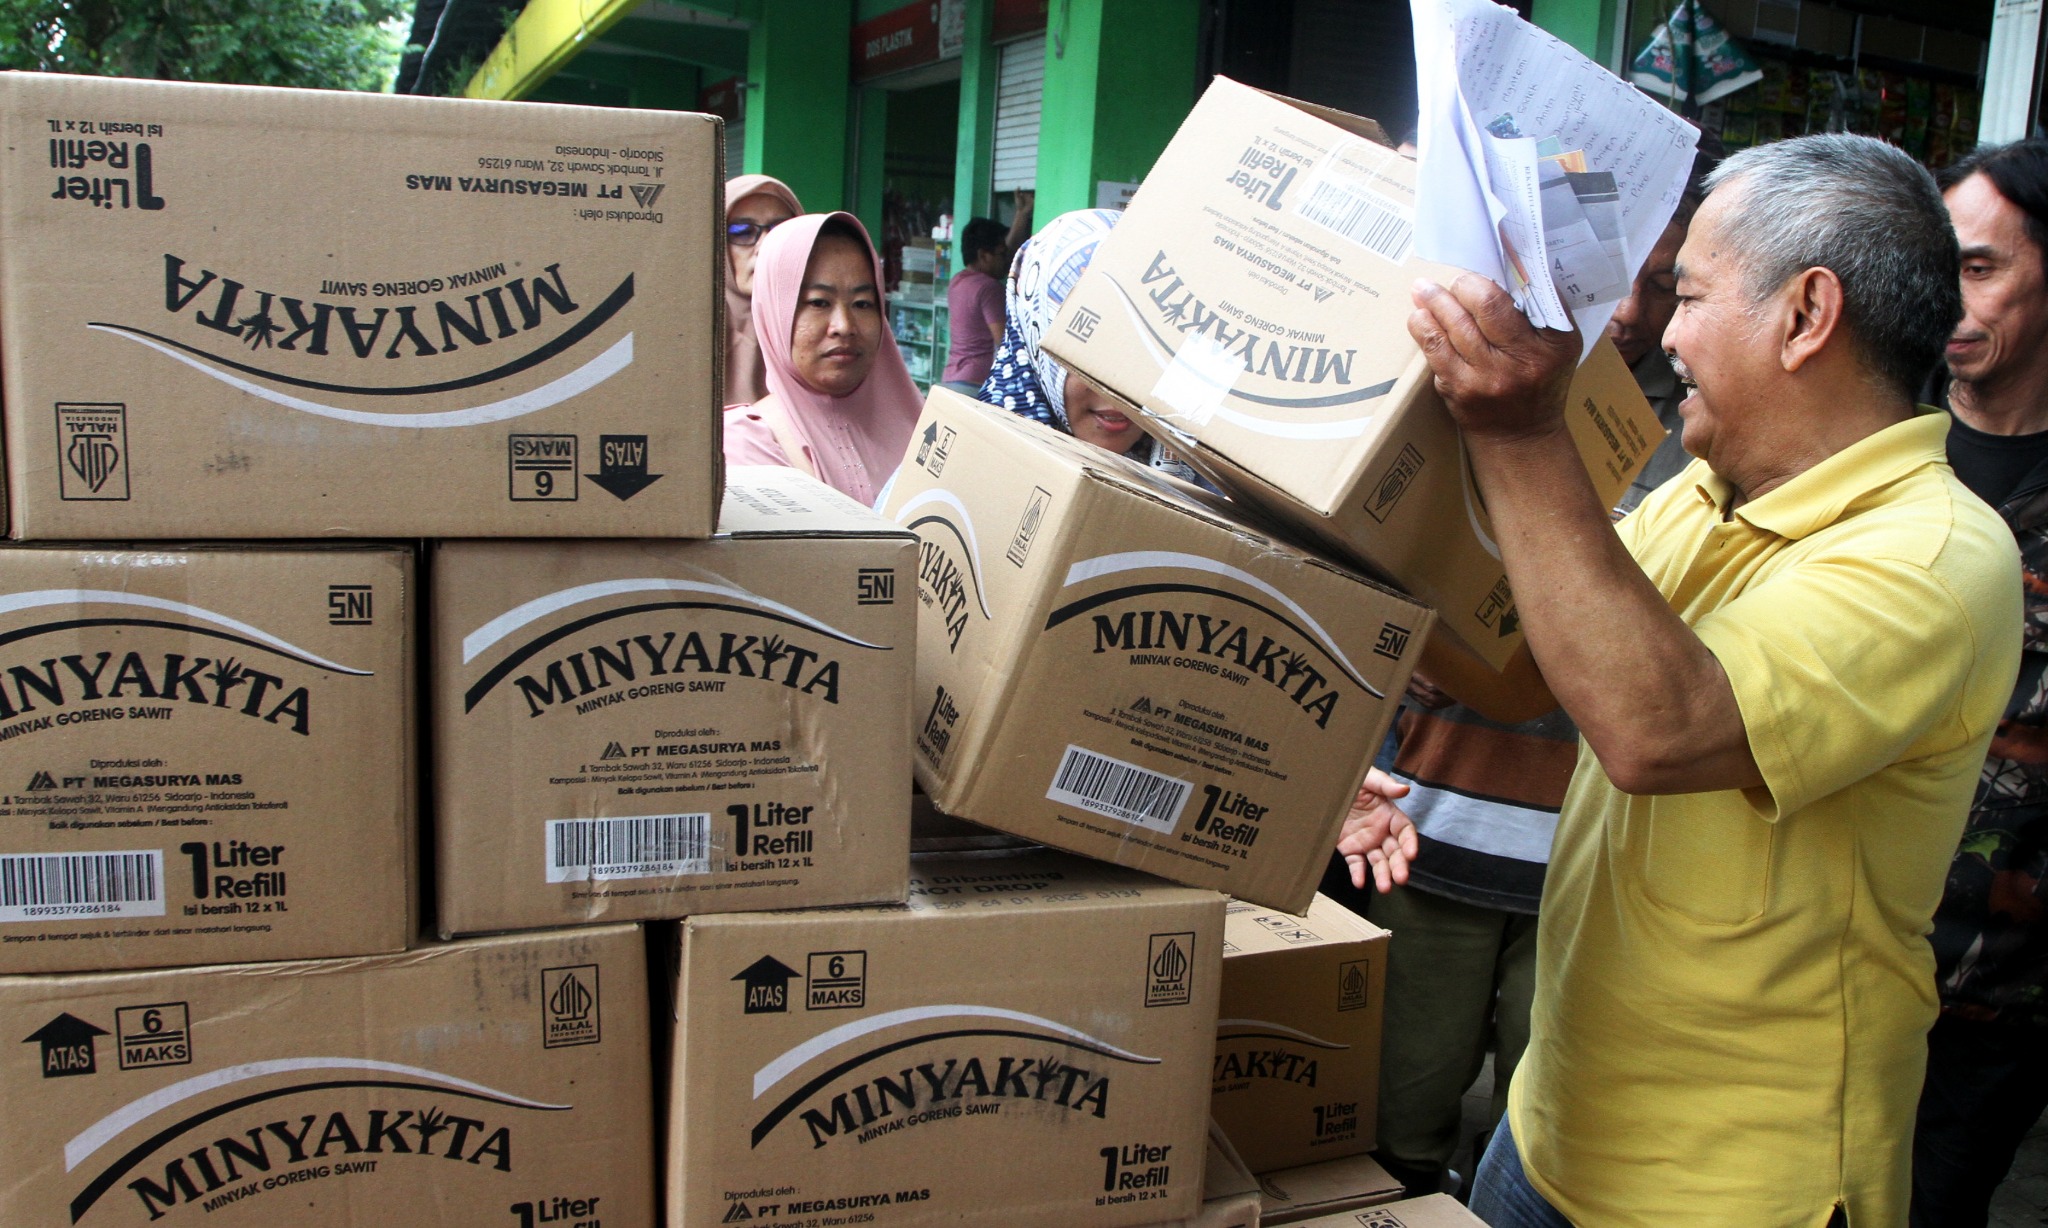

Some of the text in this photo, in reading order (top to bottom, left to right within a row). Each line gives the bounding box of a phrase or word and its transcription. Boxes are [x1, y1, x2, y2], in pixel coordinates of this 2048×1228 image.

[47, 119, 163, 138] Isi bersih 12 1L
[50, 138, 128, 169] Refill
[478, 156, 512, 169] 61256
[515, 159, 544, 172] Waru
[555, 145, 664, 162] Sidoarjo Indonesia
[1239, 147, 1287, 179] Refill
[135, 143, 165, 210] 1
[567, 162, 605, 175] Sawah
[607, 164, 650, 177] Tambak
[51, 175, 130, 210] Liter
[405, 174, 622, 199] PT MEGASURYA MAS
[1226, 170, 1271, 202] Liter
[1266, 163, 1297, 211] 1
[579, 208, 664, 224] Diproduksi oleh
[1213, 236, 1312, 291] PT MEGASURYA MAS
[320, 262, 507, 298] MINYAK GORENG SAWIT
[164, 253, 579, 359] MINYAKITA
[1140, 250, 1358, 385] MINYAKITA
[1067, 308, 1100, 341] SNI
[1218, 300, 1325, 343] MINYAK GORENG SAWIT
[66, 423, 117, 433] HALAL
[941, 433, 951, 449] 6
[514, 441, 571, 457] MAKS
[605, 442, 644, 467] ATAS
[535, 471, 553, 496] 6
[858, 572, 894, 602] SNI
[919, 542, 969, 654] YAKITA
[329, 590, 373, 620] SNI
[1375, 628, 1409, 657] SNI
[514, 631, 840, 719] MINYAKITA
[1092, 610, 1340, 730] MINYAKITA
[1129, 654, 1250, 687] MINYAK GORENG SAWIT
[576, 680, 726, 716] MINYAK GORENG SAWIT
[938, 693, 959, 728] Liter
[0, 706, 173, 742] MINYAK GORENG SAWIT
[654, 728, 715, 739] Diproduksi oleh
[1154, 707, 1269, 751] PT MEGASURYA MAS
[631, 740, 781, 758] PT MEGASURYA MAS
[928, 720, 951, 756] Refill
[90, 759, 163, 770] Diproduksi oleh
[589, 764, 621, 773] Tambak
[623, 762, 650, 772] Sawah
[666, 761, 687, 770] Waru
[688, 760, 712, 769] 61256
[753, 756, 790, 766] Indonesia
[62, 774, 243, 788] PT MEGASURYA MAS
[753, 802, 814, 827] Liter
[1195, 784, 1222, 831] 1
[1219, 790, 1269, 822] Liter
[726, 804, 748, 856] 1
[1210, 817, 1259, 847] Refill
[213, 840, 285, 868] Liter
[753, 831, 813, 856] Refill
[180, 842, 208, 899] 1
[592, 863, 674, 875] 18993379286184
[726, 857, 813, 872] Isi bersih 12 1L
[215, 872, 286, 899] Refill
[973, 882, 1051, 893] DROP
[23, 904, 121, 916] 18993379286184
[184, 902, 288, 916] Isi bersih 12 1L
[829, 956, 844, 978] 6
[749, 985, 783, 1008] ATAS
[812, 989, 861, 1005] MAKS
[1152, 983, 1185, 993] HALAL
[142, 1009, 163, 1034] 6
[551, 1020, 592, 1033] HALAL
[47, 1045, 90, 1071] ATAS
[126, 1044, 187, 1064] MAKS
[800, 1056, 1109, 1149] MINYAKITA
[1326, 1102, 1357, 1119] Liter
[857, 1103, 1000, 1144] MINYAK GORENG SAWIT
[1325, 1116, 1356, 1136] Refill
[127, 1107, 511, 1221] MINYAKITA
[1121, 1143, 1172, 1166] Liter
[1100, 1146, 1118, 1192] 1
[1119, 1166, 1169, 1191] Refill
[202, 1161, 377, 1213] MINYAK GORENG SAWIT
[724, 1186, 795, 1201] Diproduksi oleh
[539, 1196, 600, 1222] Liter
[758, 1188, 930, 1218] PT MEGASURYA MAS
[822, 1216, 846, 1226] Waru
[848, 1213, 875, 1224] 61256
